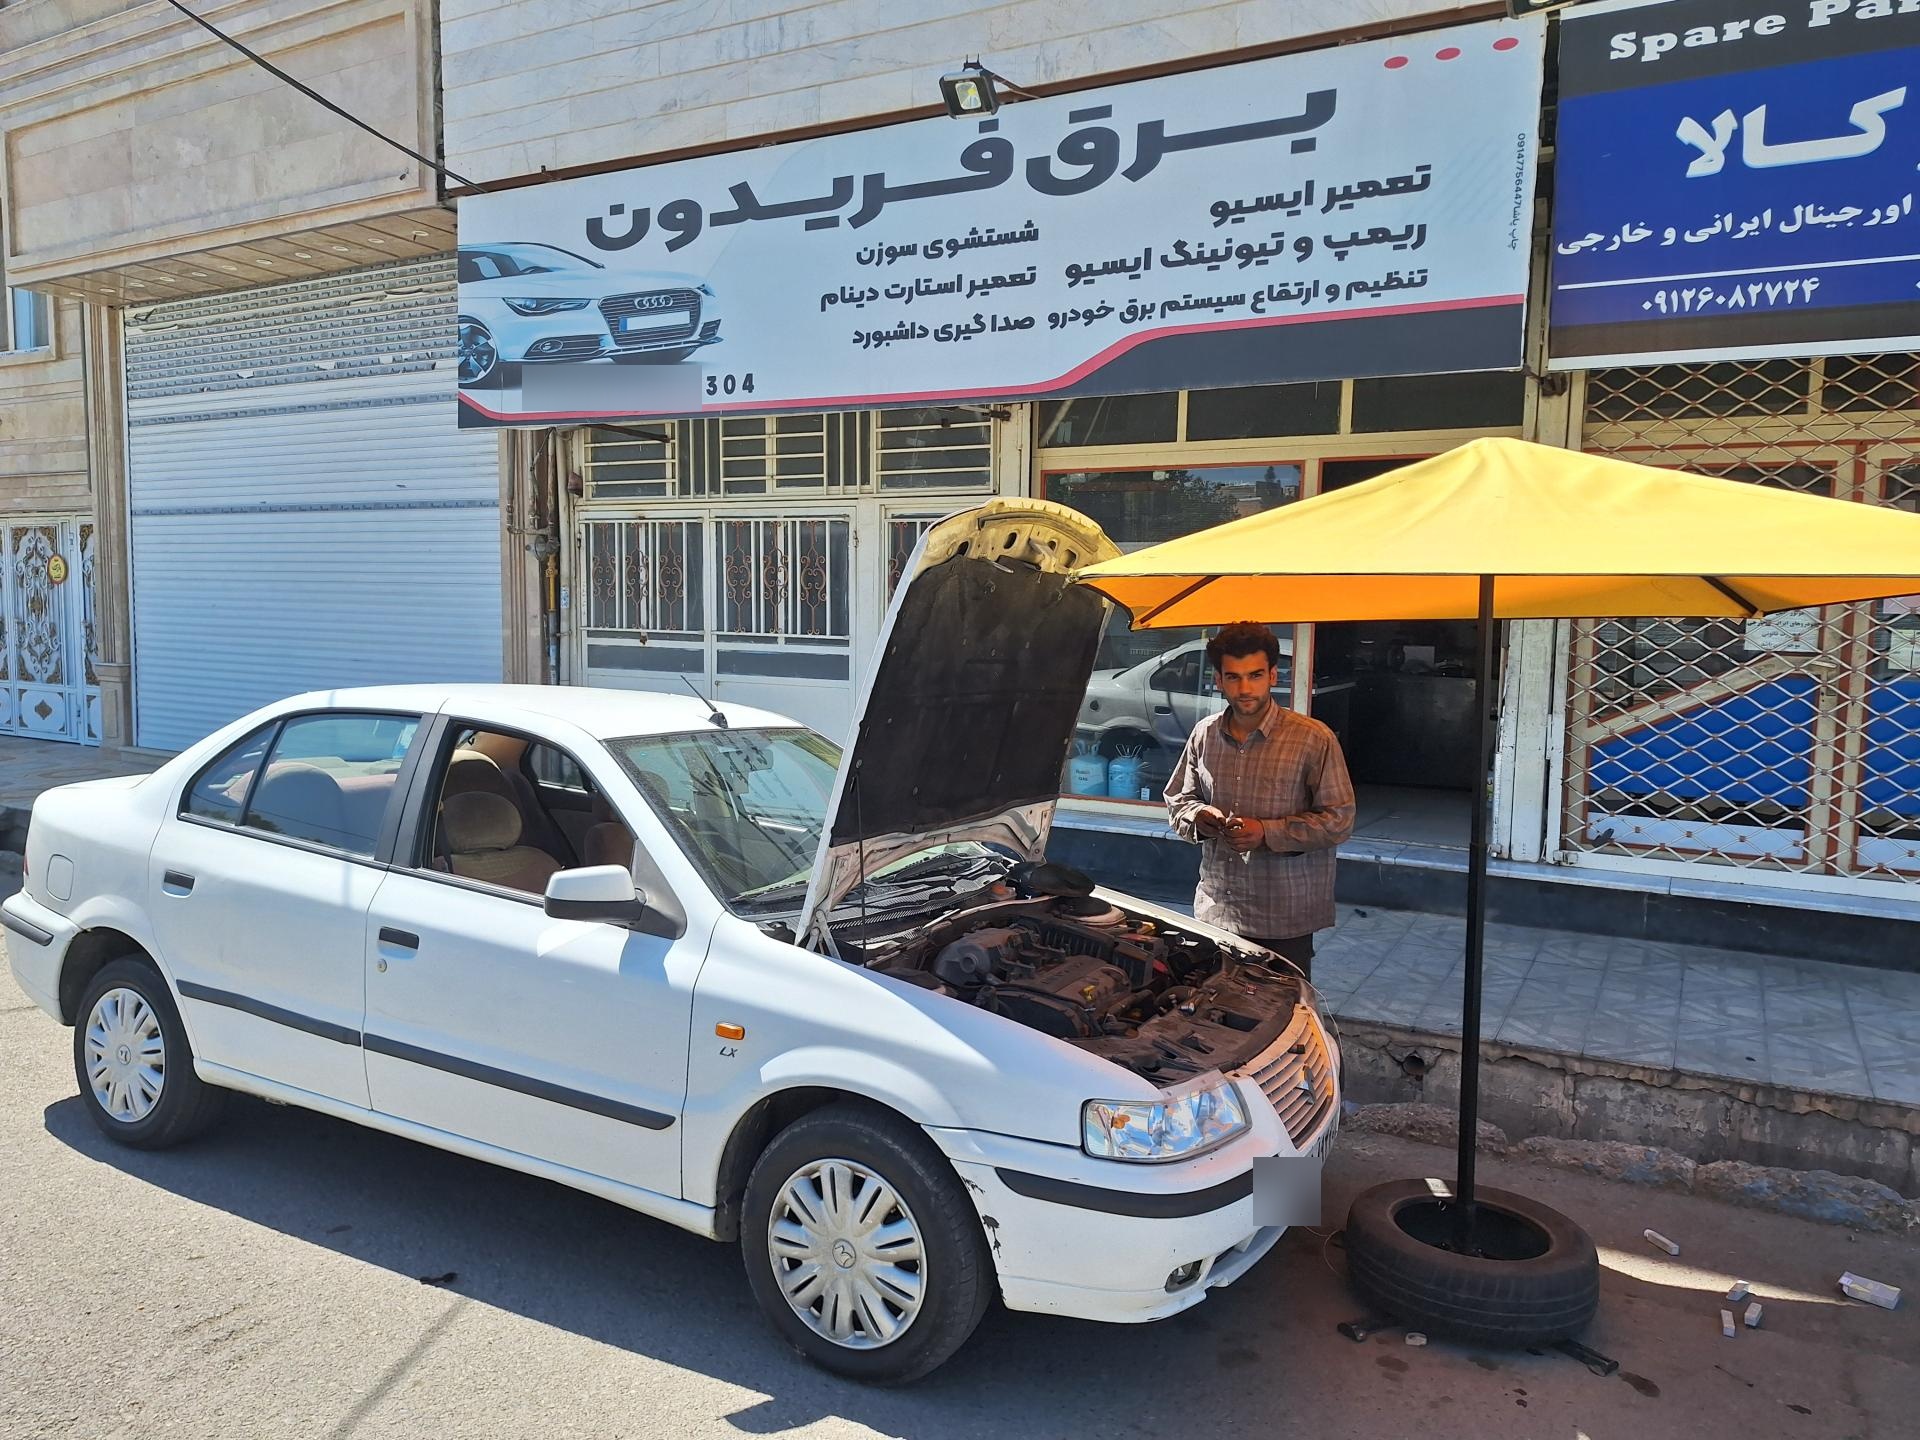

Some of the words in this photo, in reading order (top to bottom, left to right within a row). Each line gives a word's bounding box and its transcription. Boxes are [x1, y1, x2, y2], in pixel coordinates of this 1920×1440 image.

[1610, 15, 1787, 62] Spare
[1026, 88, 1337, 196] برق
[1676, 87, 1906, 177] کالا
[586, 119, 1014, 252] فریدون
[1321, 164, 1432, 214] تعمیر
[1210, 180, 1314, 228] ایسیو
[923, 219, 1039, 259] شستشوی
[1557, 223, 1654, 255] خارجی
[1661, 227, 1676, 246] و
[1684, 209, 1771, 242] ایرانی
[856, 242, 918, 267] سوزن
[1161, 232, 1284, 271] تیونینگ
[1293, 236, 1313, 263] و
[1324, 224, 1427, 261] ریمپ
[966, 266, 1037, 299] تعمیر
[1065, 248, 1152, 288] ایسیو
[820, 286, 880, 313] دینام
[884, 274, 963, 304] استارت
[1325, 284, 1340, 303] و
[1346, 269, 1428, 301] تنظیم
[1642, 278, 1820, 314] ۰۹۱۲۶۰۸۲۷۲۴
[1047, 300, 1115, 330] خودرو
[1119, 298, 1156, 325] برق
[1160, 293, 1246, 319] سیستم
[852, 320, 929, 350] داشبورد
[719, 1046, 738, 1058] LX
